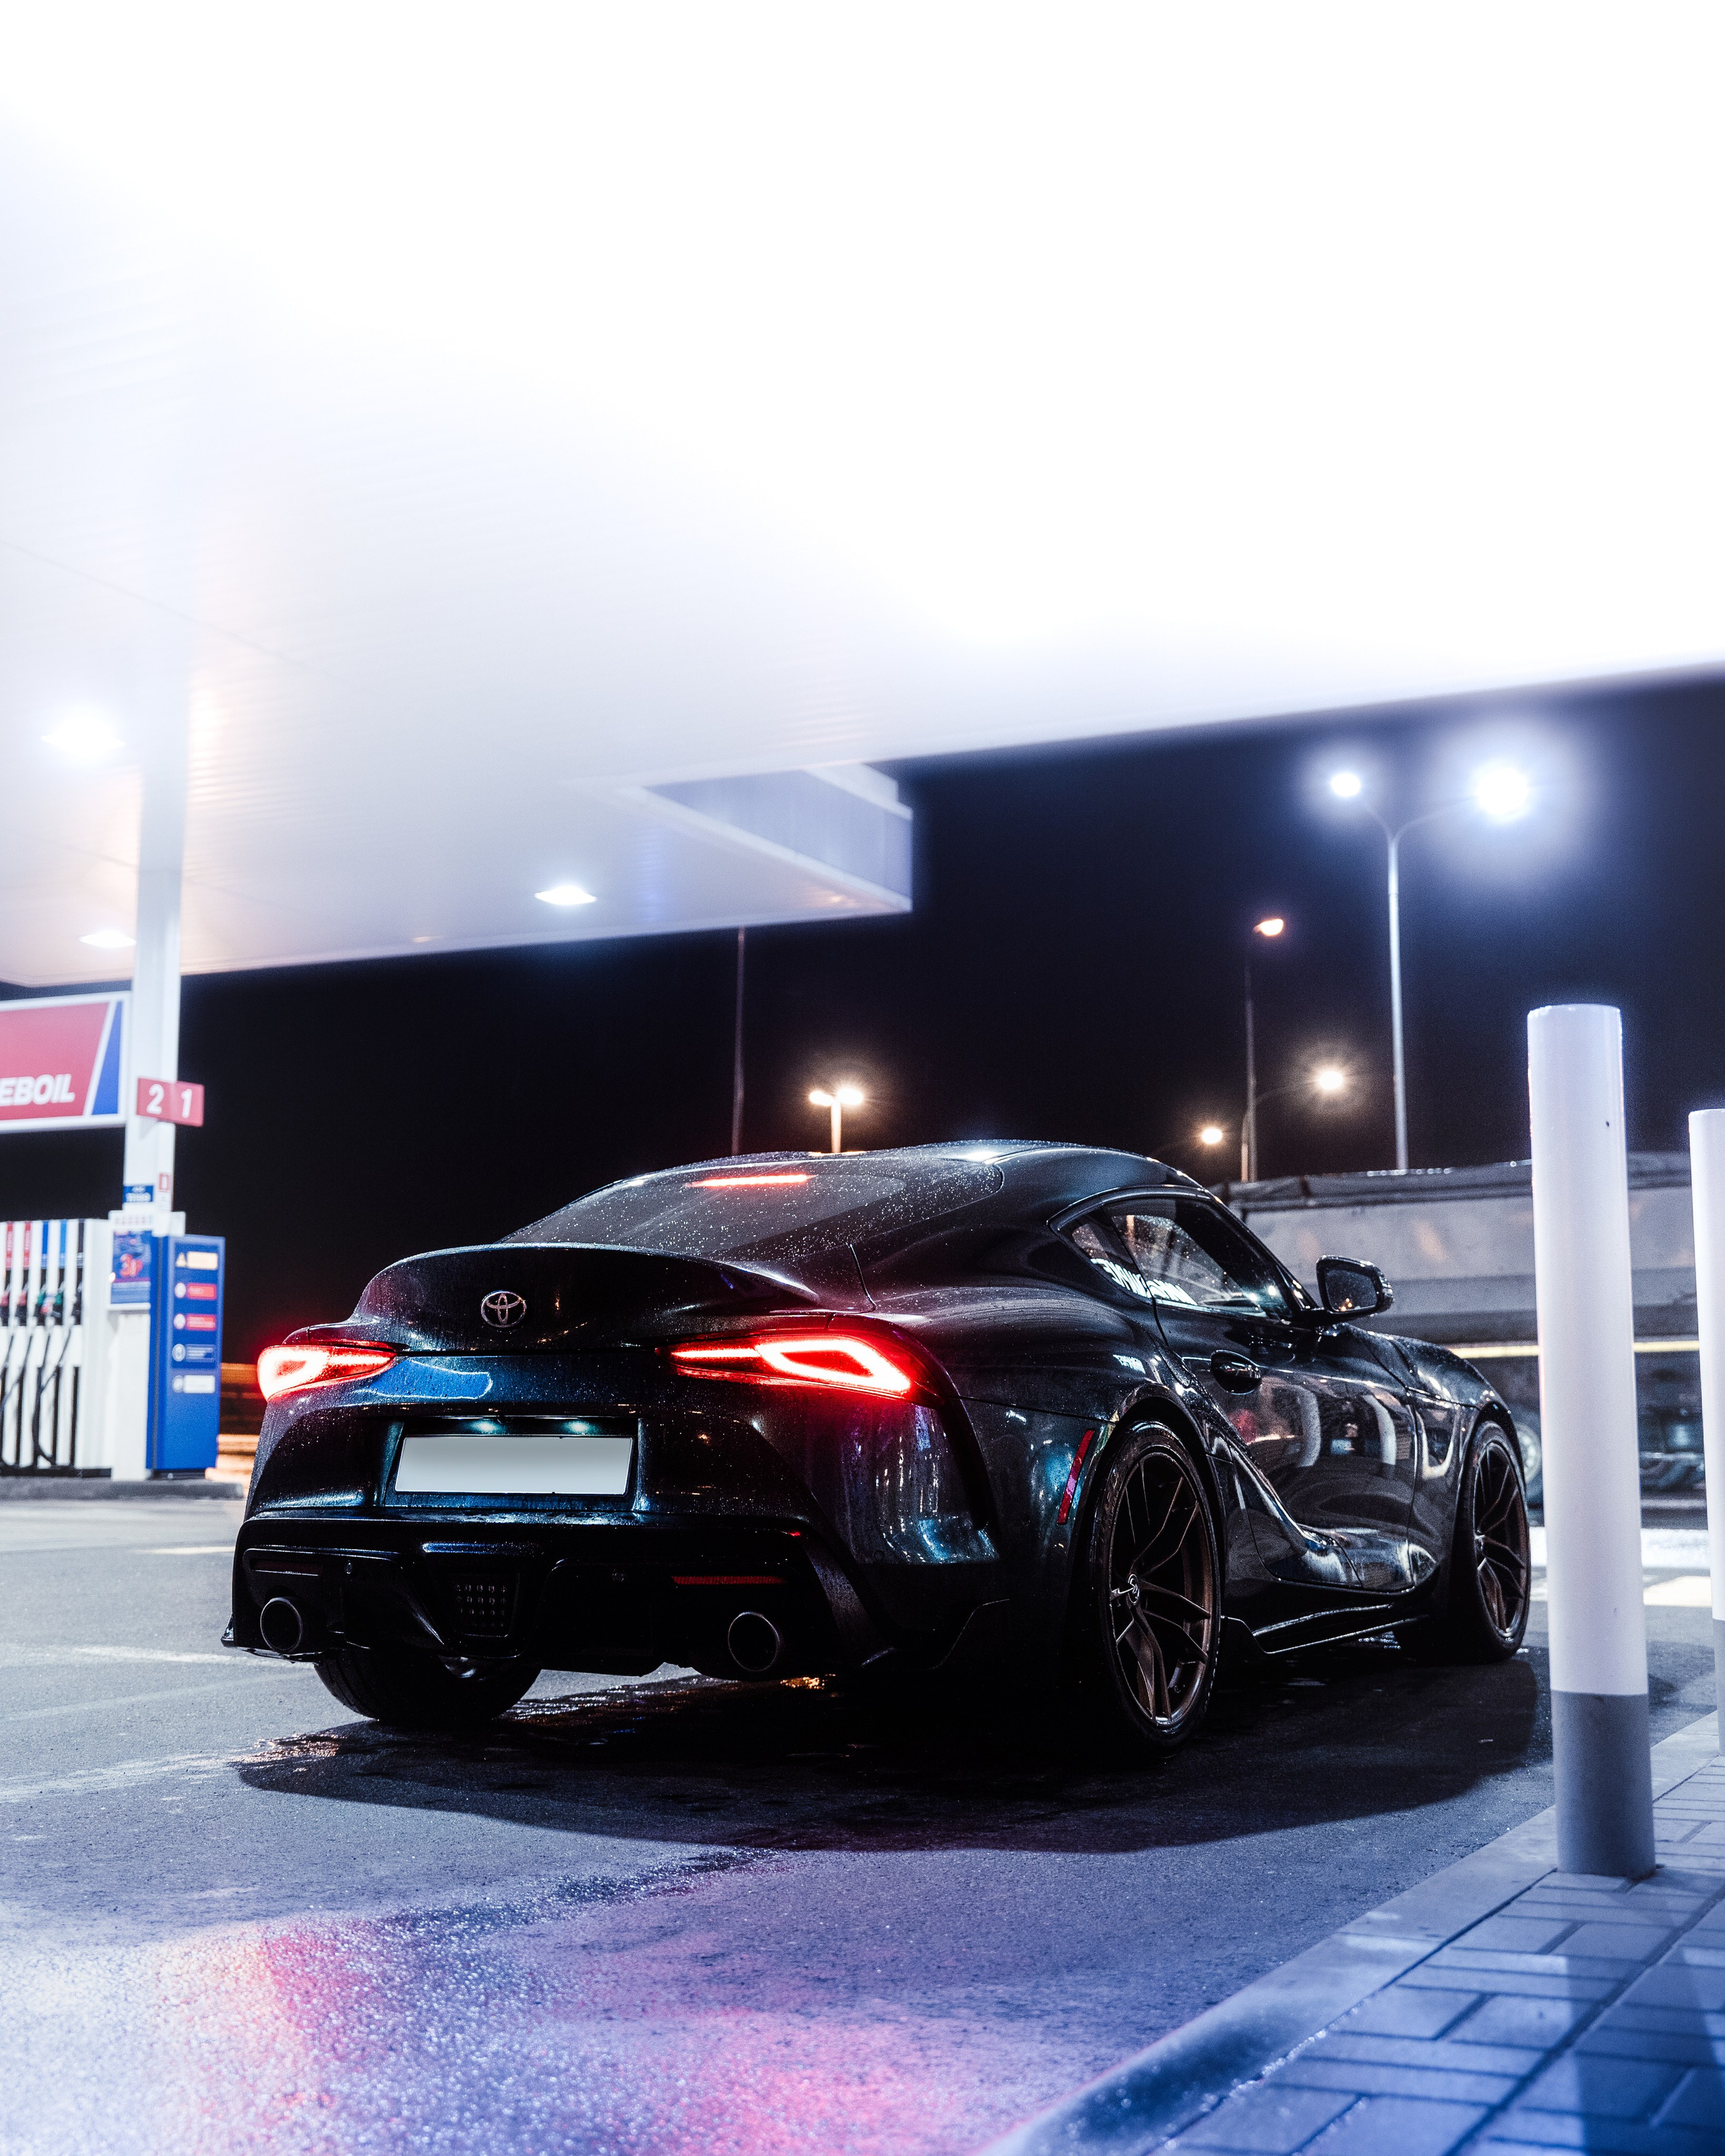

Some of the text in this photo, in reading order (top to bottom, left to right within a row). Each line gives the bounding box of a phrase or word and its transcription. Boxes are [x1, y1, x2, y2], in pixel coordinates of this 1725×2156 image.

[0, 1074, 75, 1106] EBOIL
[147, 1083, 192, 1118] 2 1
